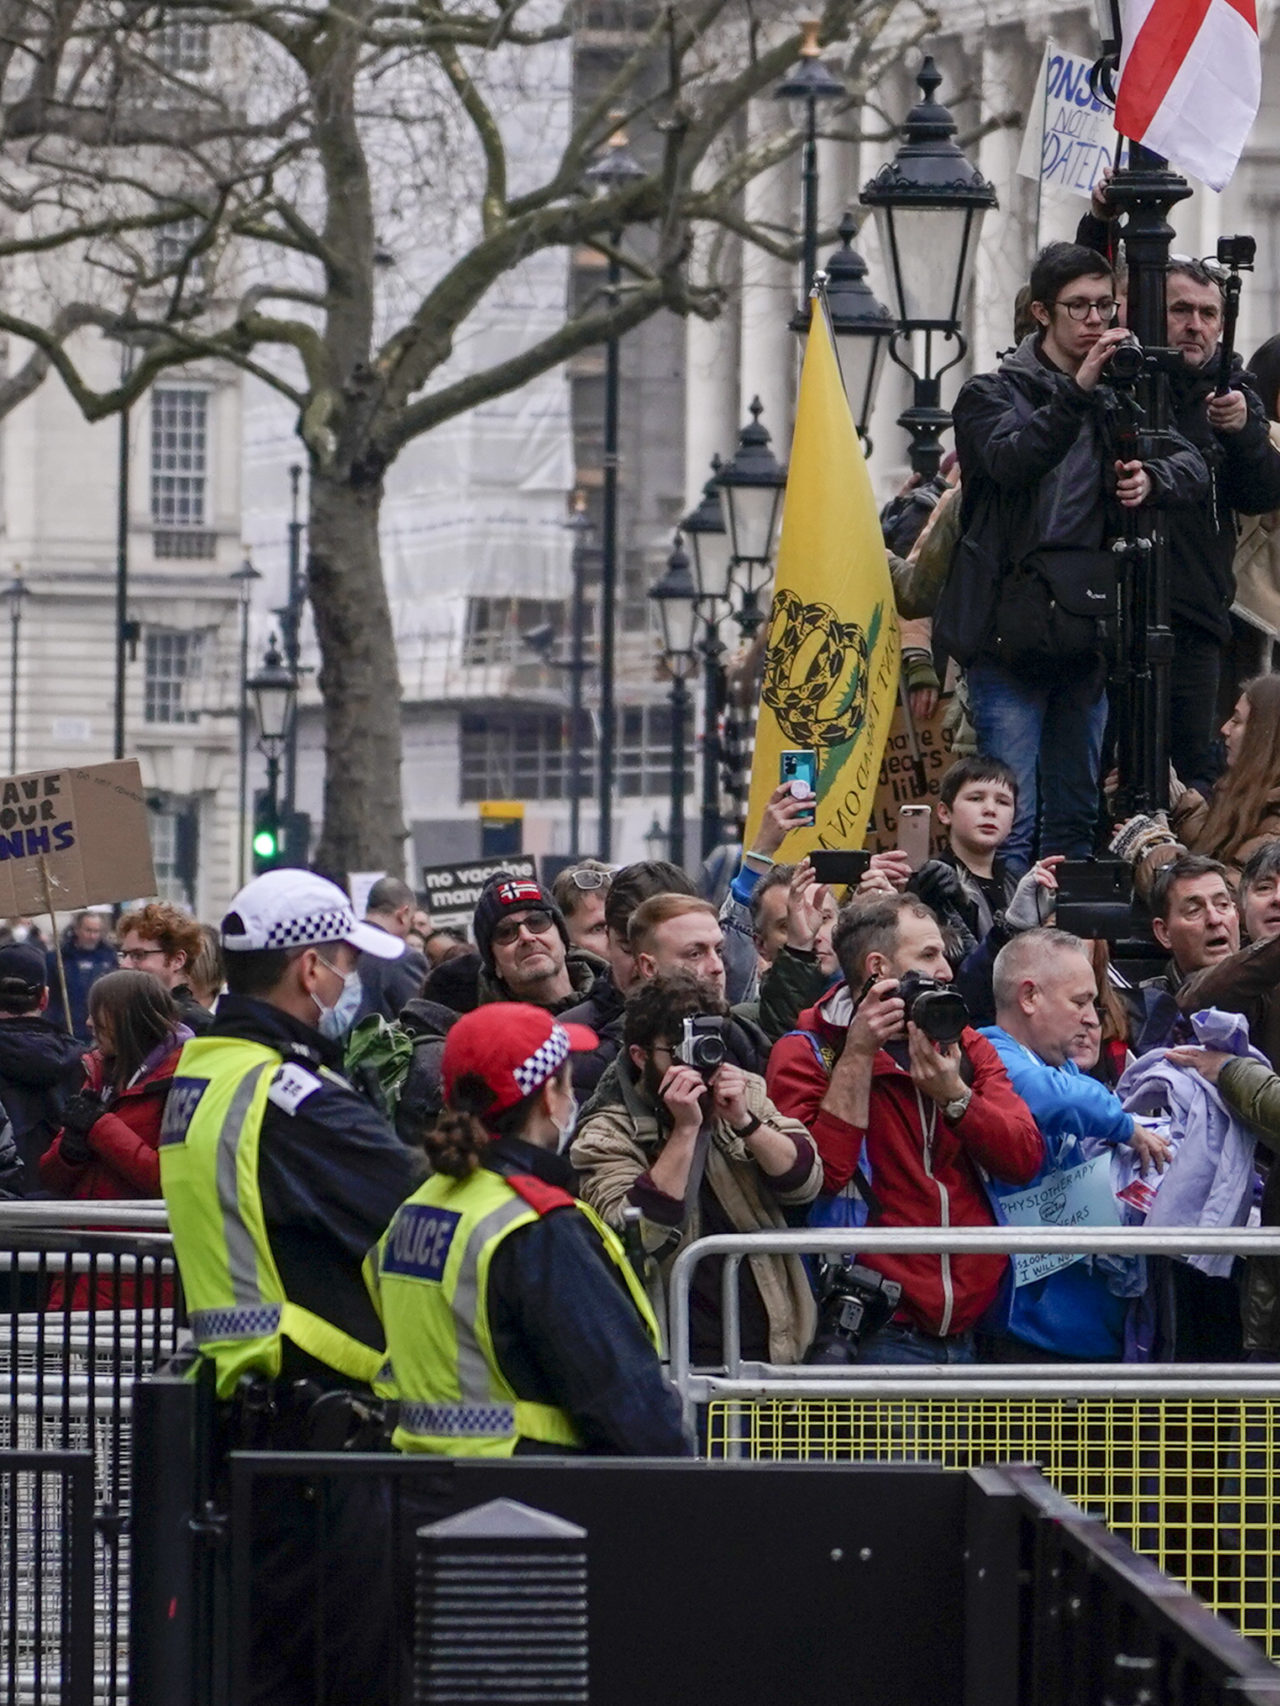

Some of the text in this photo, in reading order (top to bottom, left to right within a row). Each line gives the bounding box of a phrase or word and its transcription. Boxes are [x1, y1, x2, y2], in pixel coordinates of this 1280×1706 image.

[1051, 107, 1090, 138] NOT
[2, 774, 61, 805] AVE
[0, 821, 75, 861] NHS
[426, 872, 453, 888] no
[999, 1162, 1097, 1213] PHYSIOTHERAPY
[1020, 1268, 1029, 1282] I
[1032, 1260, 1055, 1276] WILL
